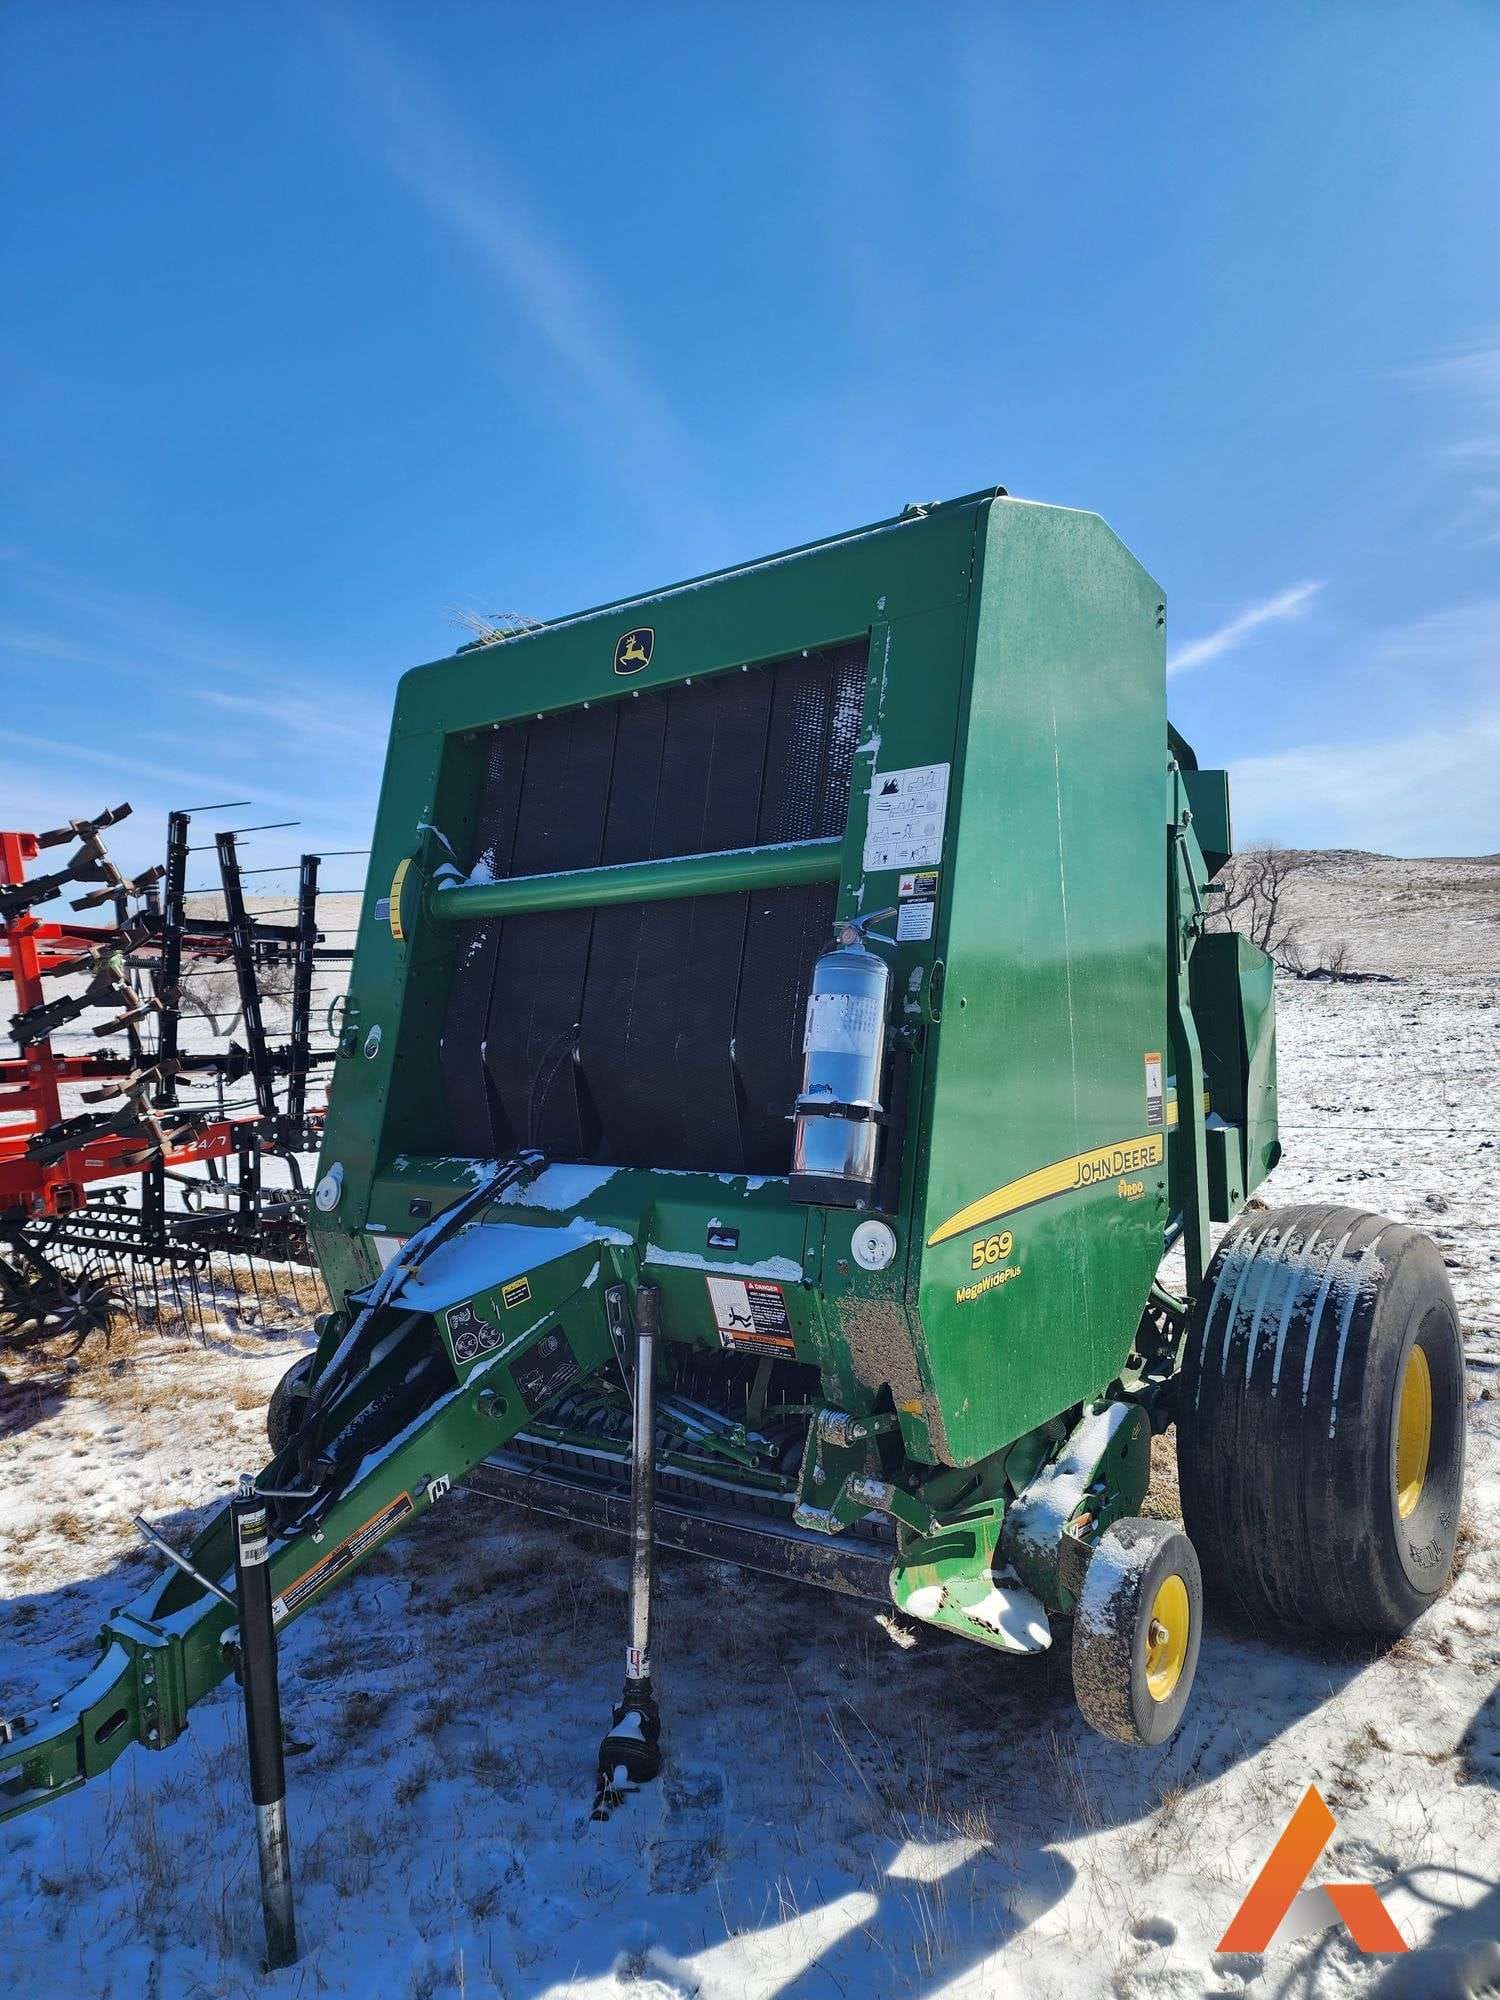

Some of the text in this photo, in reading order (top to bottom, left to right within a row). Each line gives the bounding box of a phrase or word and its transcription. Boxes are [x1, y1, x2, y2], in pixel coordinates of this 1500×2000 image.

[187, 1136, 227, 1152] 24/7
[1073, 1146, 1156, 1186] JOHN DEERE
[971, 1230, 1013, 1270] 569
[755, 1284, 779, 1292] DANGER
[956, 1265, 1021, 1304] MegaWidePlus
